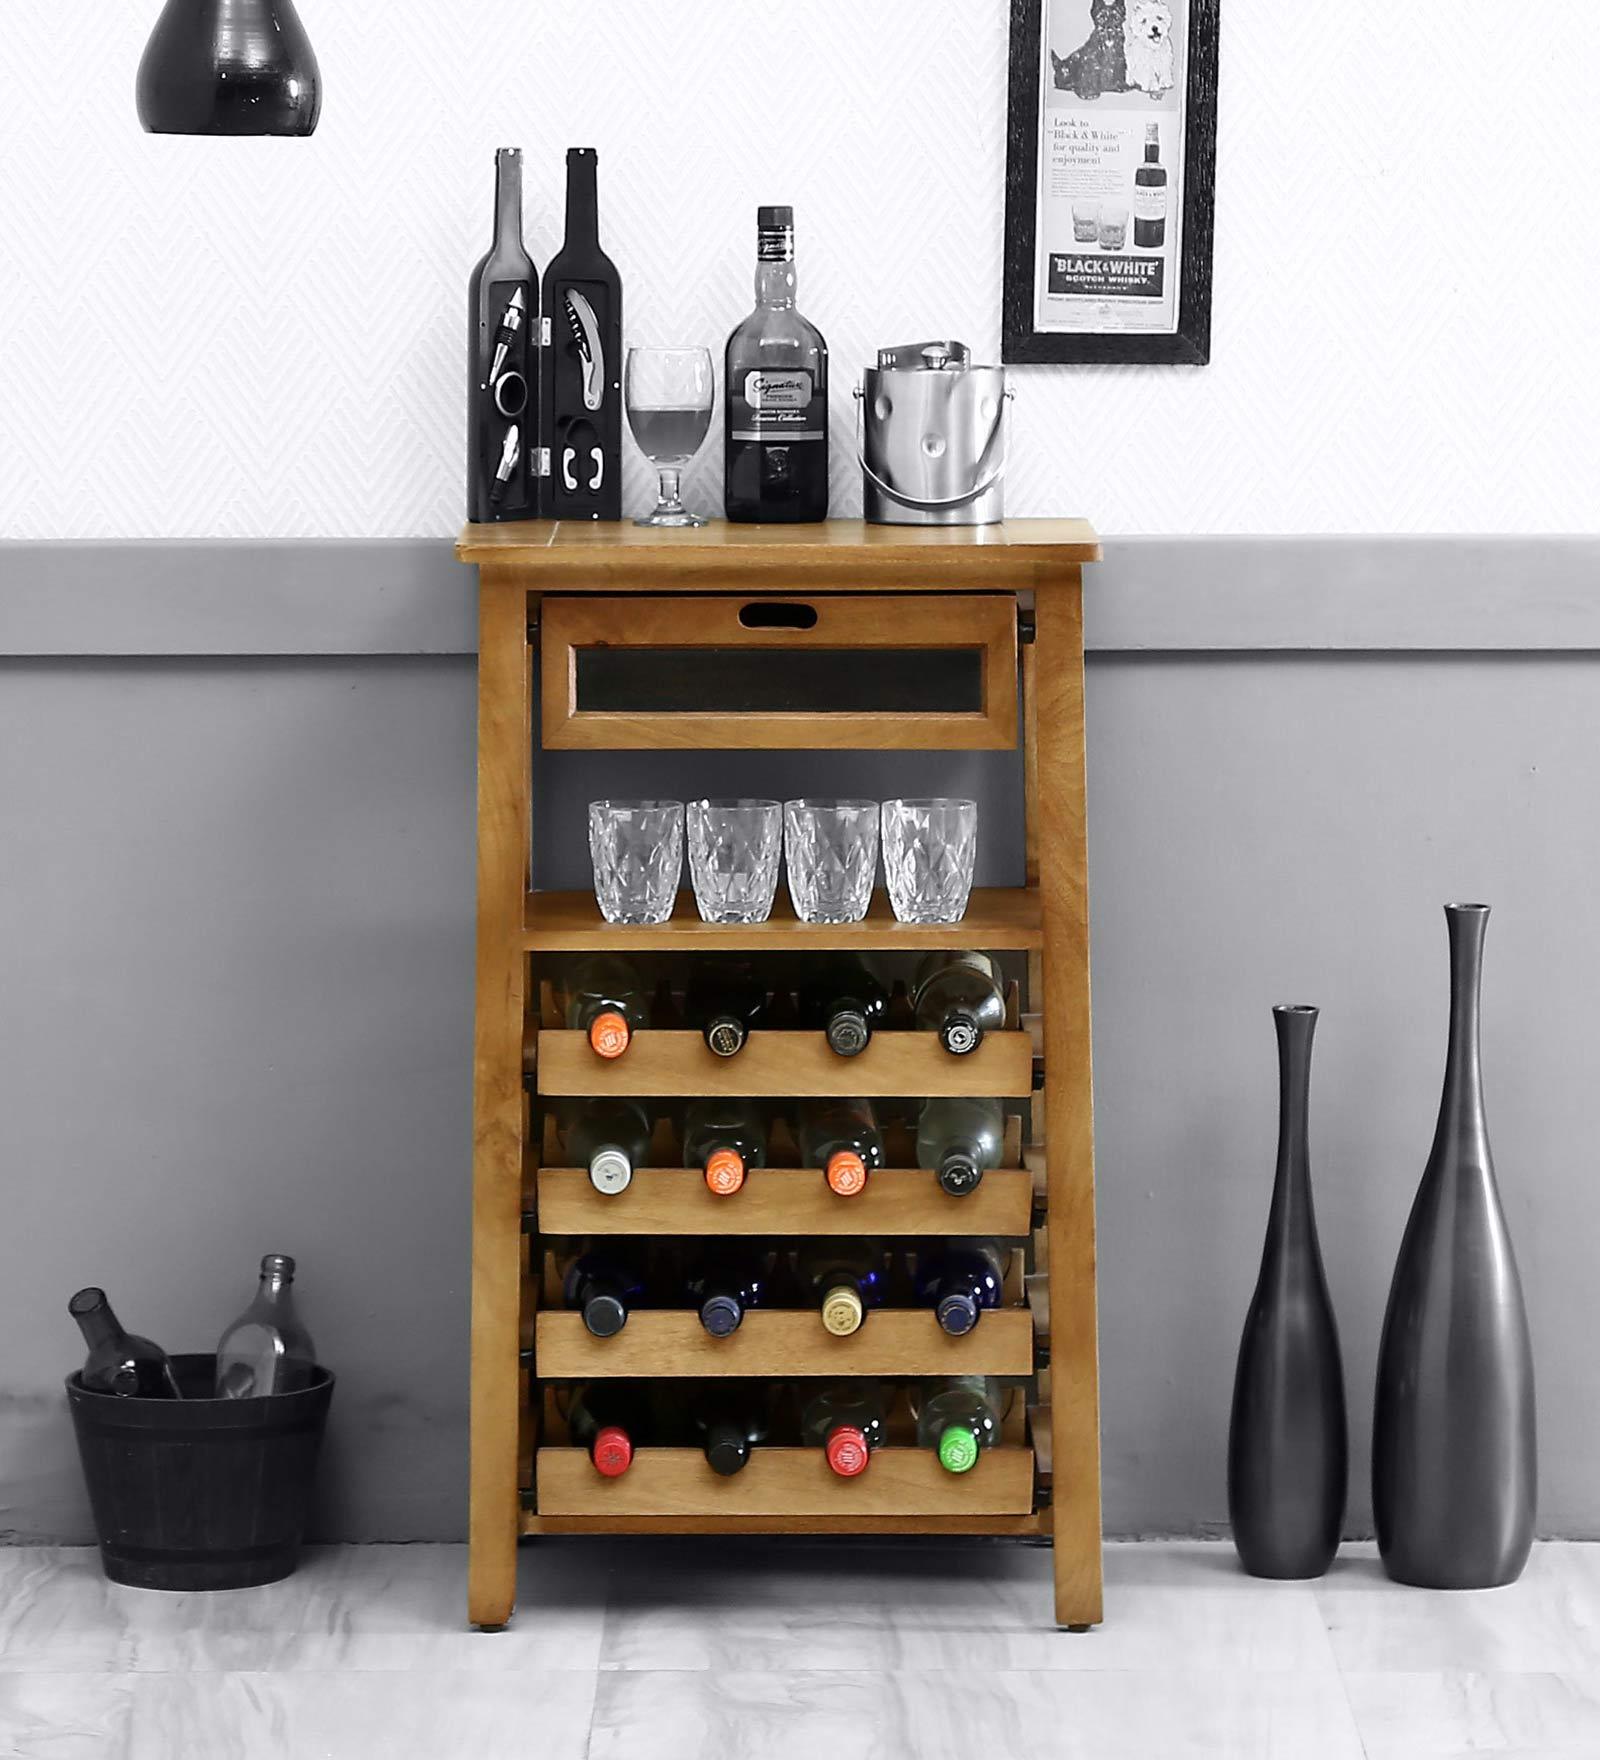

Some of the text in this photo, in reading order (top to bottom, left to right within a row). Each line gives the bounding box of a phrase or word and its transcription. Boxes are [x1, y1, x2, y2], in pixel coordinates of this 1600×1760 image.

[1054, 117, 1089, 127] Look to
[1081, 130, 1089, 139] &
[1053, 143, 1120, 155] for quality and
[1052, 155, 1101, 166] enjoyment
[1065, 275, 1105, 283] SCOTCH
